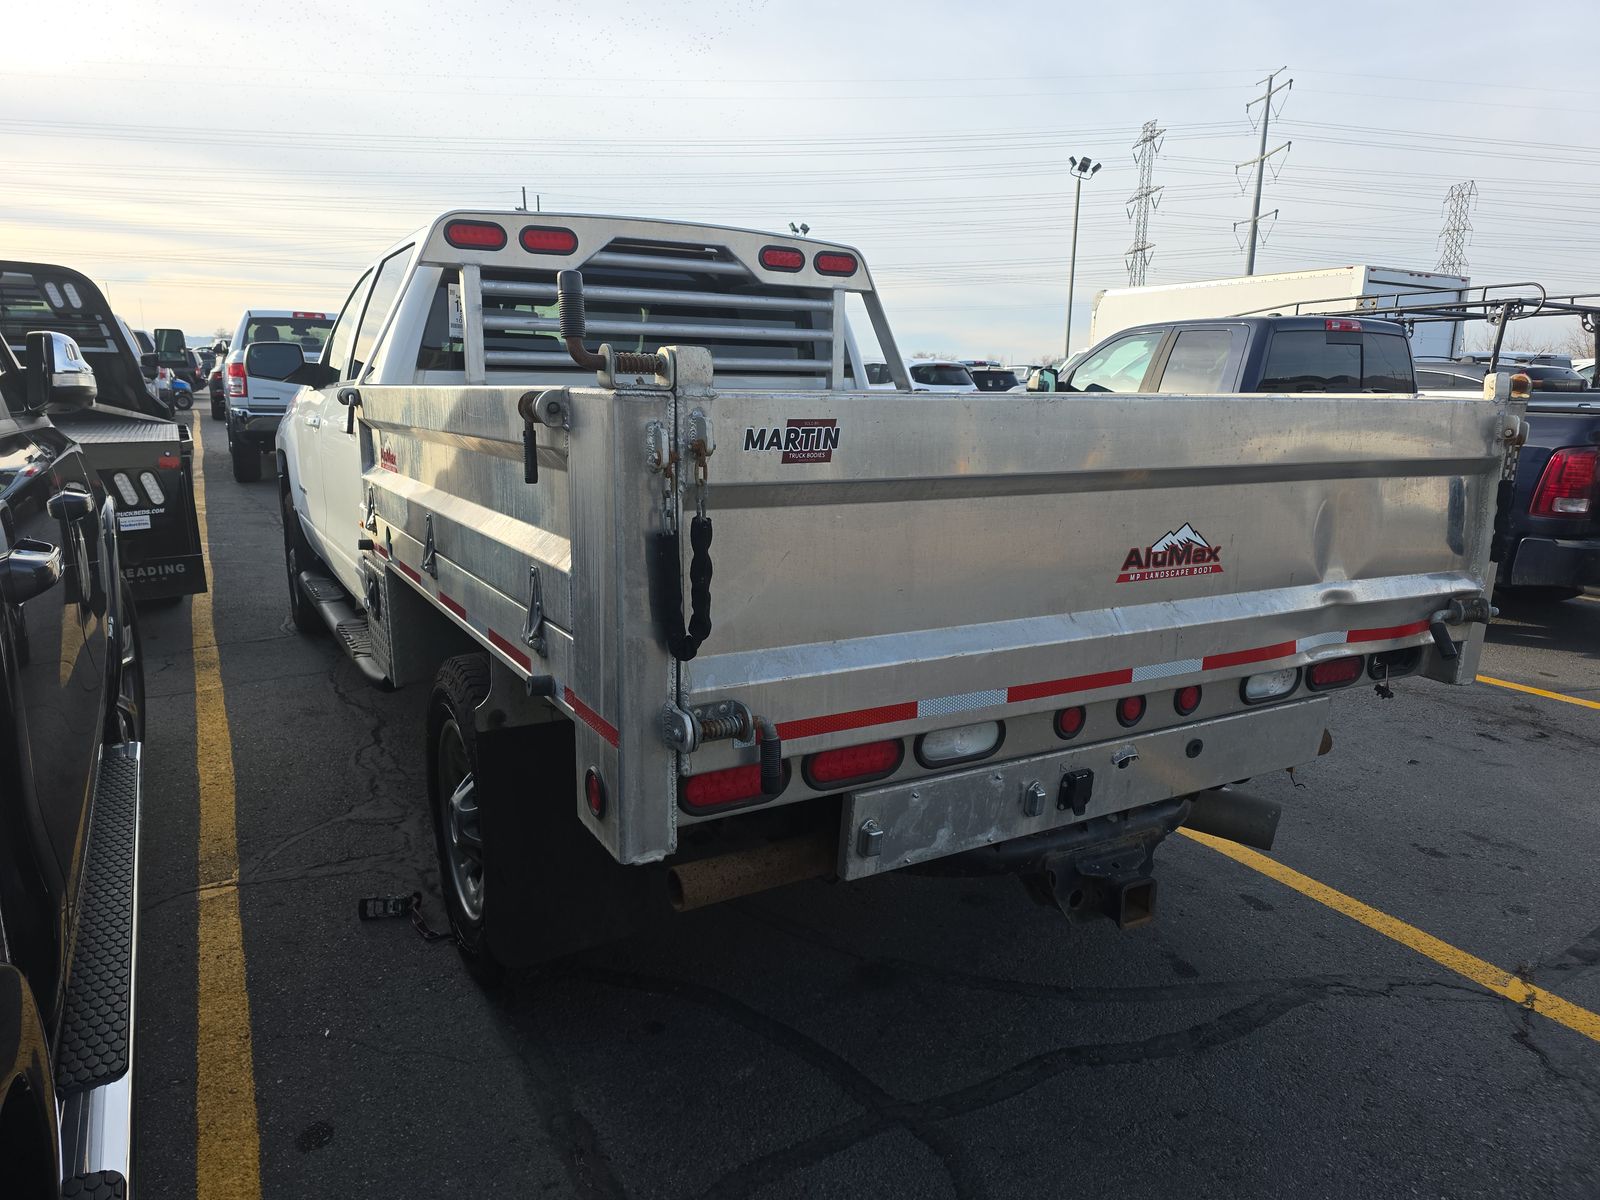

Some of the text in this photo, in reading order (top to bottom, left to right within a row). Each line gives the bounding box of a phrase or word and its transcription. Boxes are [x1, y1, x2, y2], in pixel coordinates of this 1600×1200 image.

[743, 427, 840, 451] MARTIN
[1121, 543, 1222, 571] AluMax
[1129, 566, 1213, 581] MP LANDSCAPE BODY
